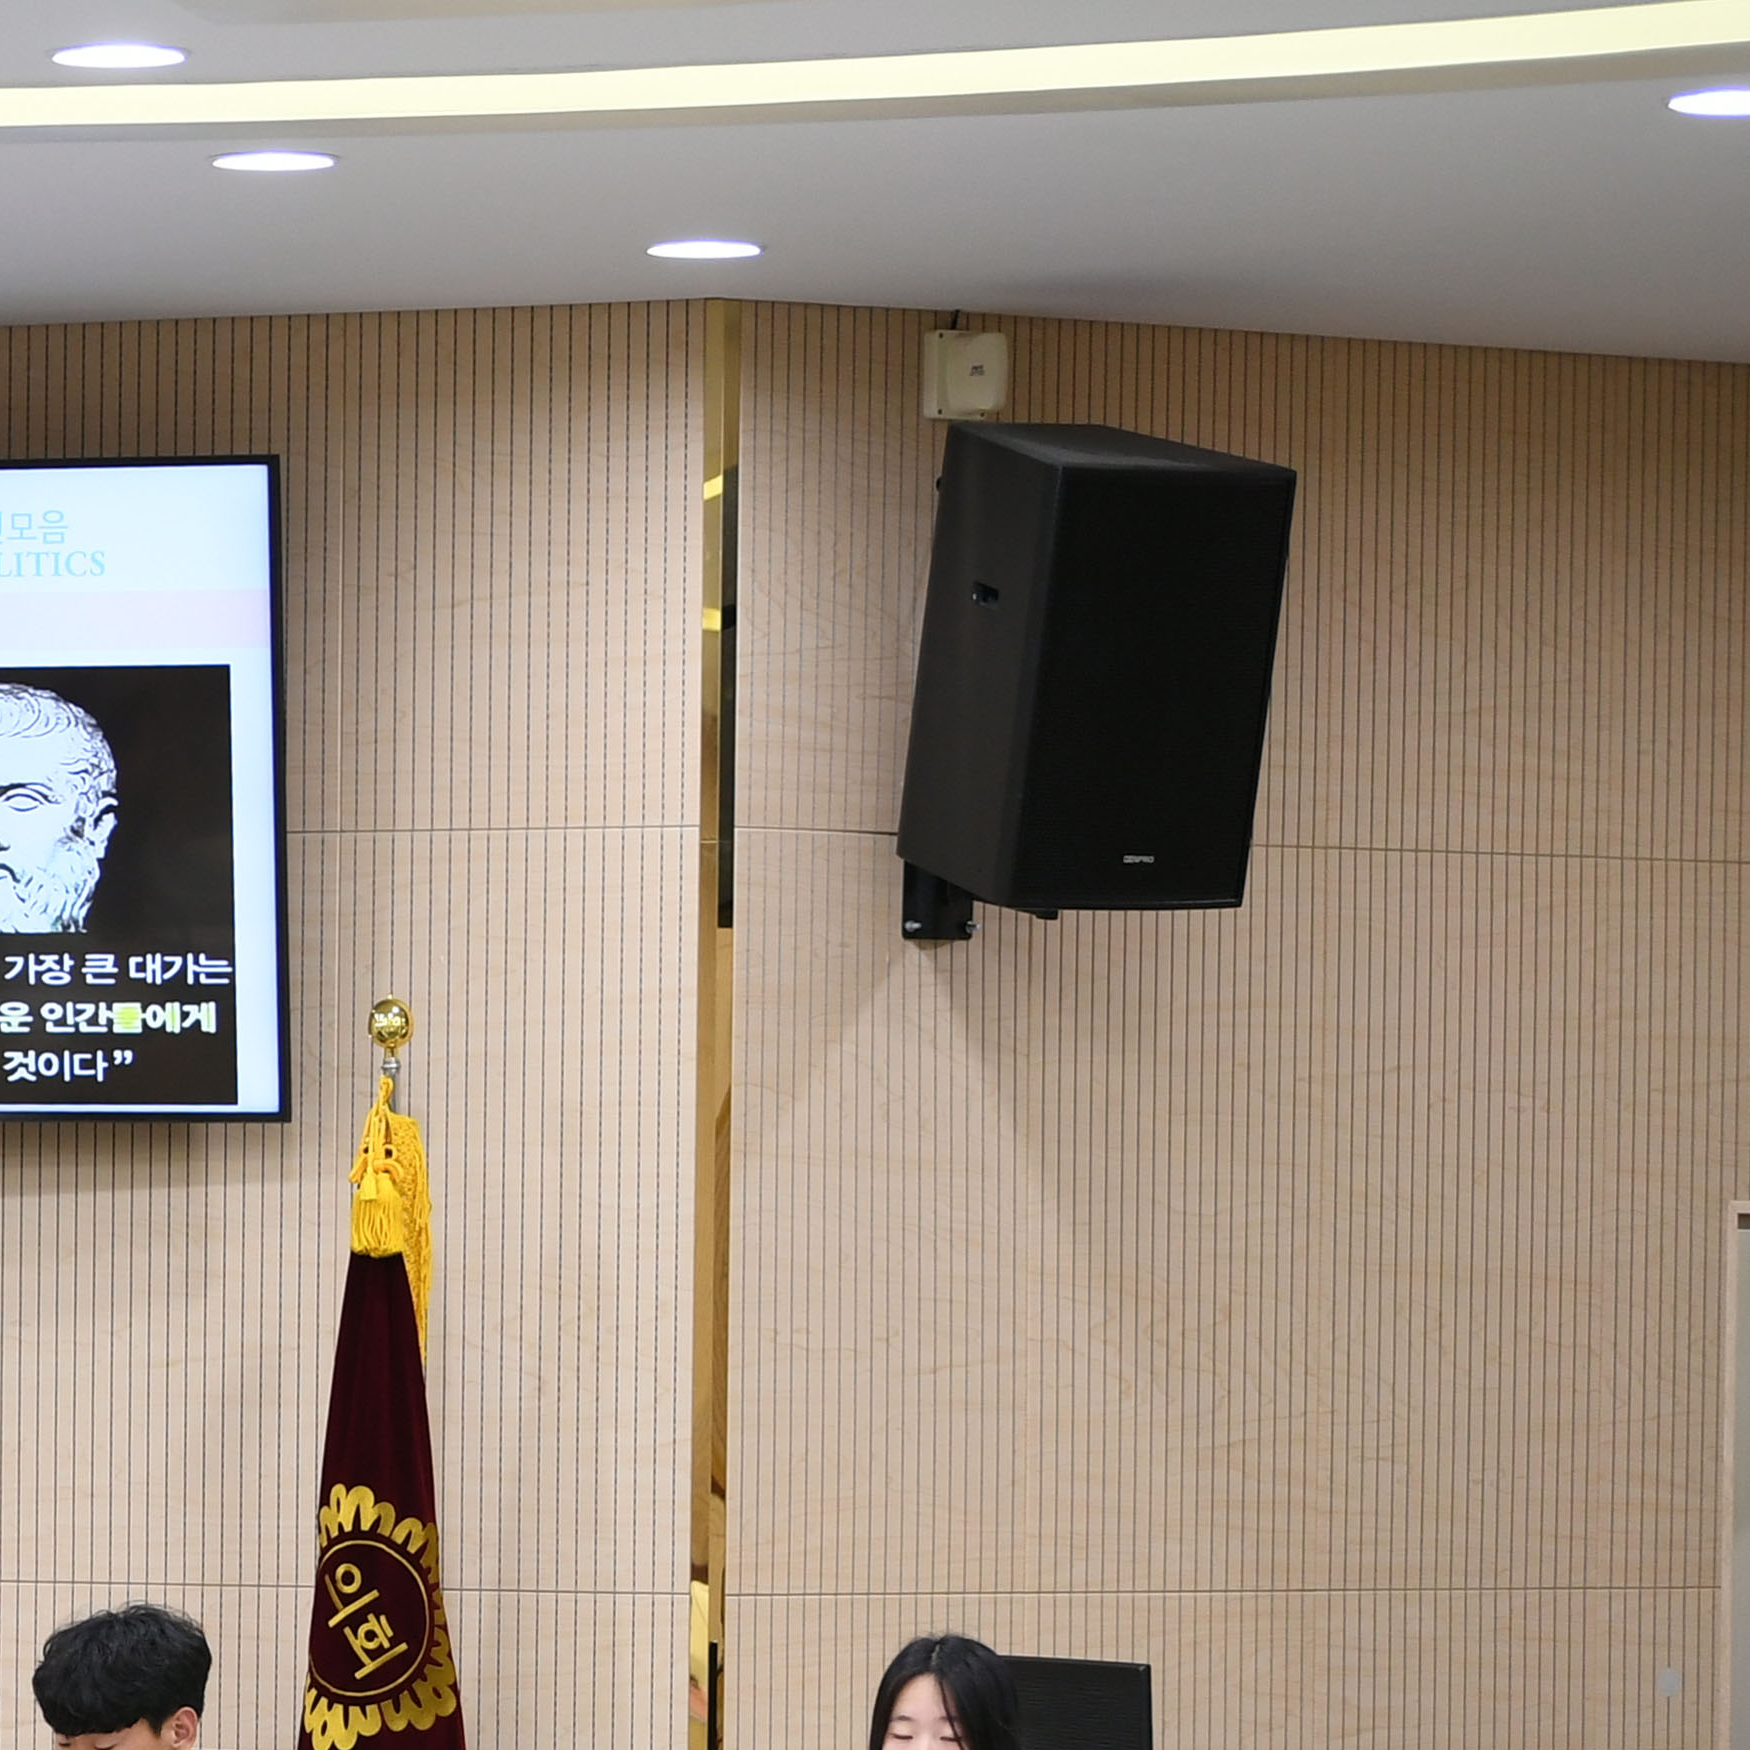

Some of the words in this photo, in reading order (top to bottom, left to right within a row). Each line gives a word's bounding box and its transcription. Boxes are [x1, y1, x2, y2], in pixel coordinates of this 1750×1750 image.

[4, 952, 75, 986] 가장
[81, 953, 119, 985] 큰
[128, 952, 233, 985] 대가는
[39, 1001, 217, 1034] 인간들에게
[324, 1563, 408, 1680] 의회
